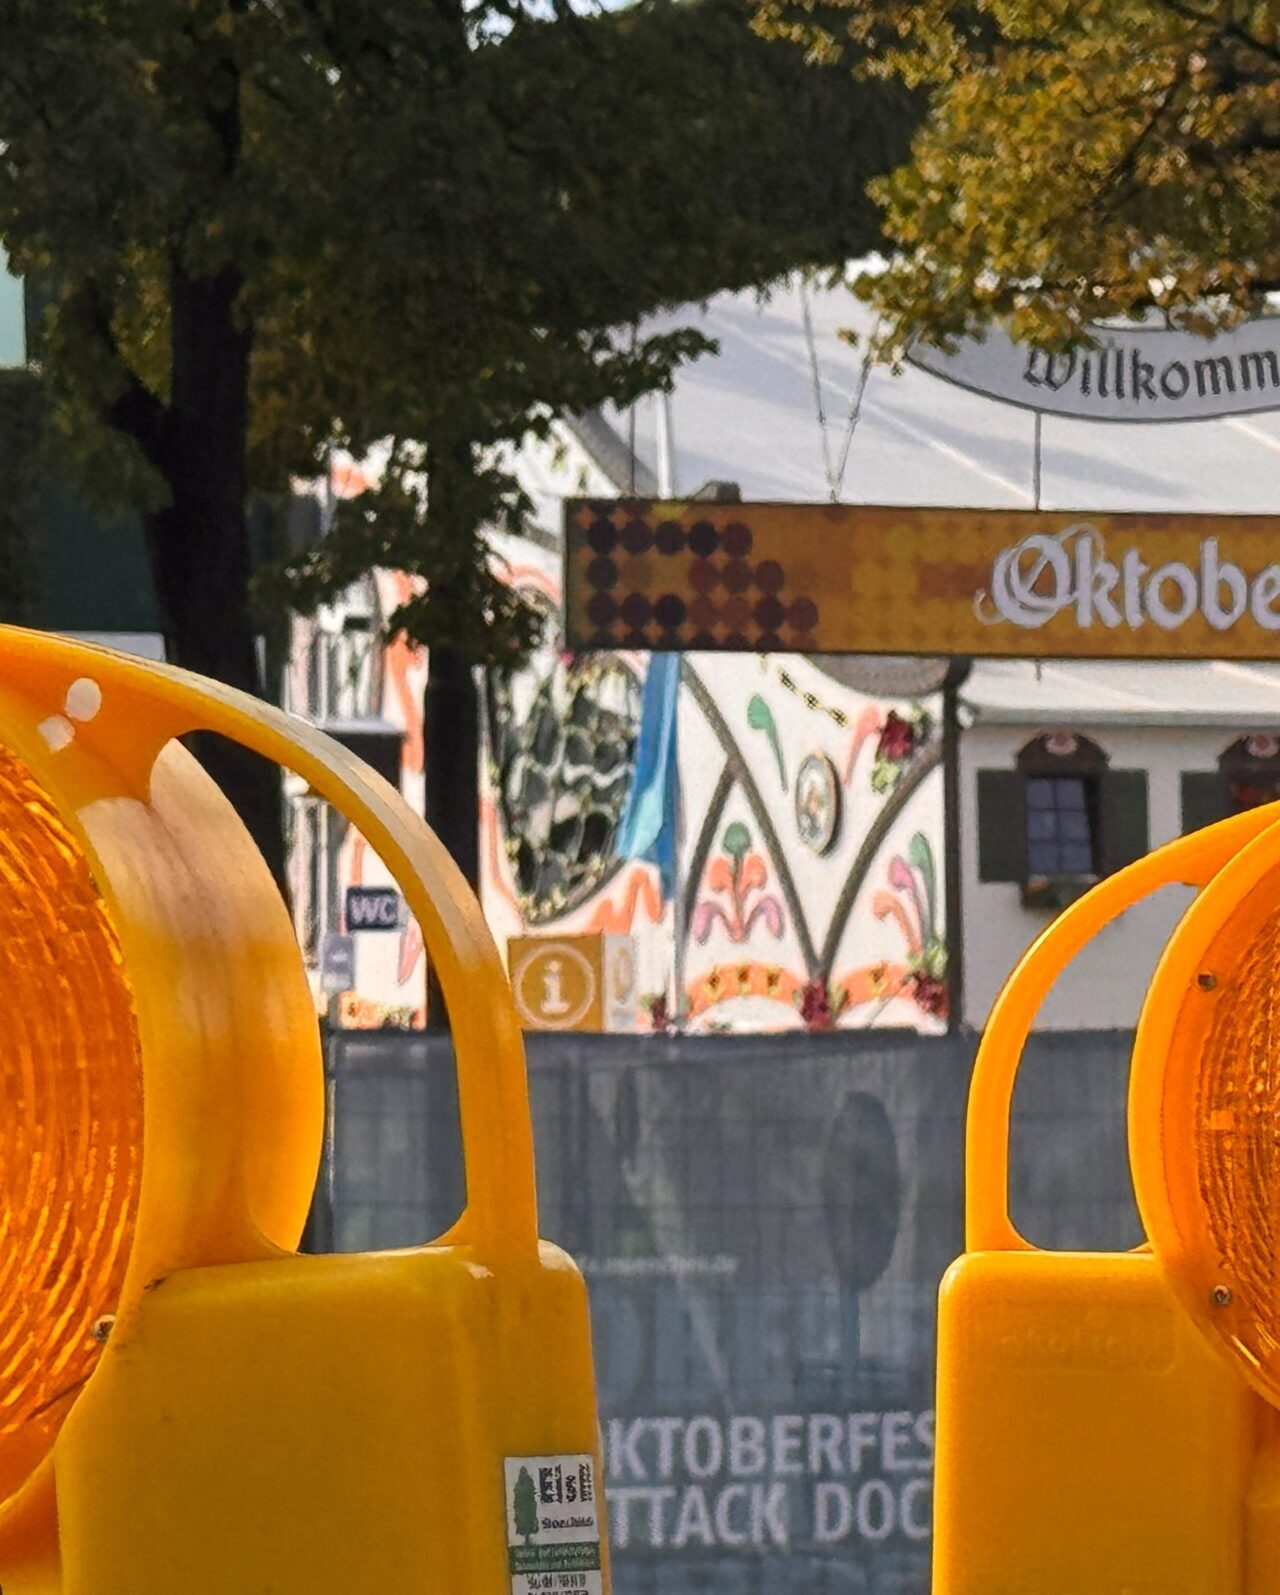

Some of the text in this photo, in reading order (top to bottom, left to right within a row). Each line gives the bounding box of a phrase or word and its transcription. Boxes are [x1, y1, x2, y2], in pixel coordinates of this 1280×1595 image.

[351, 894, 397, 924] WC
[606, 1409, 934, 1479] KTOBERFES
[604, 1481, 789, 1549] TTACK
[813, 1478, 933, 1541] DOC
